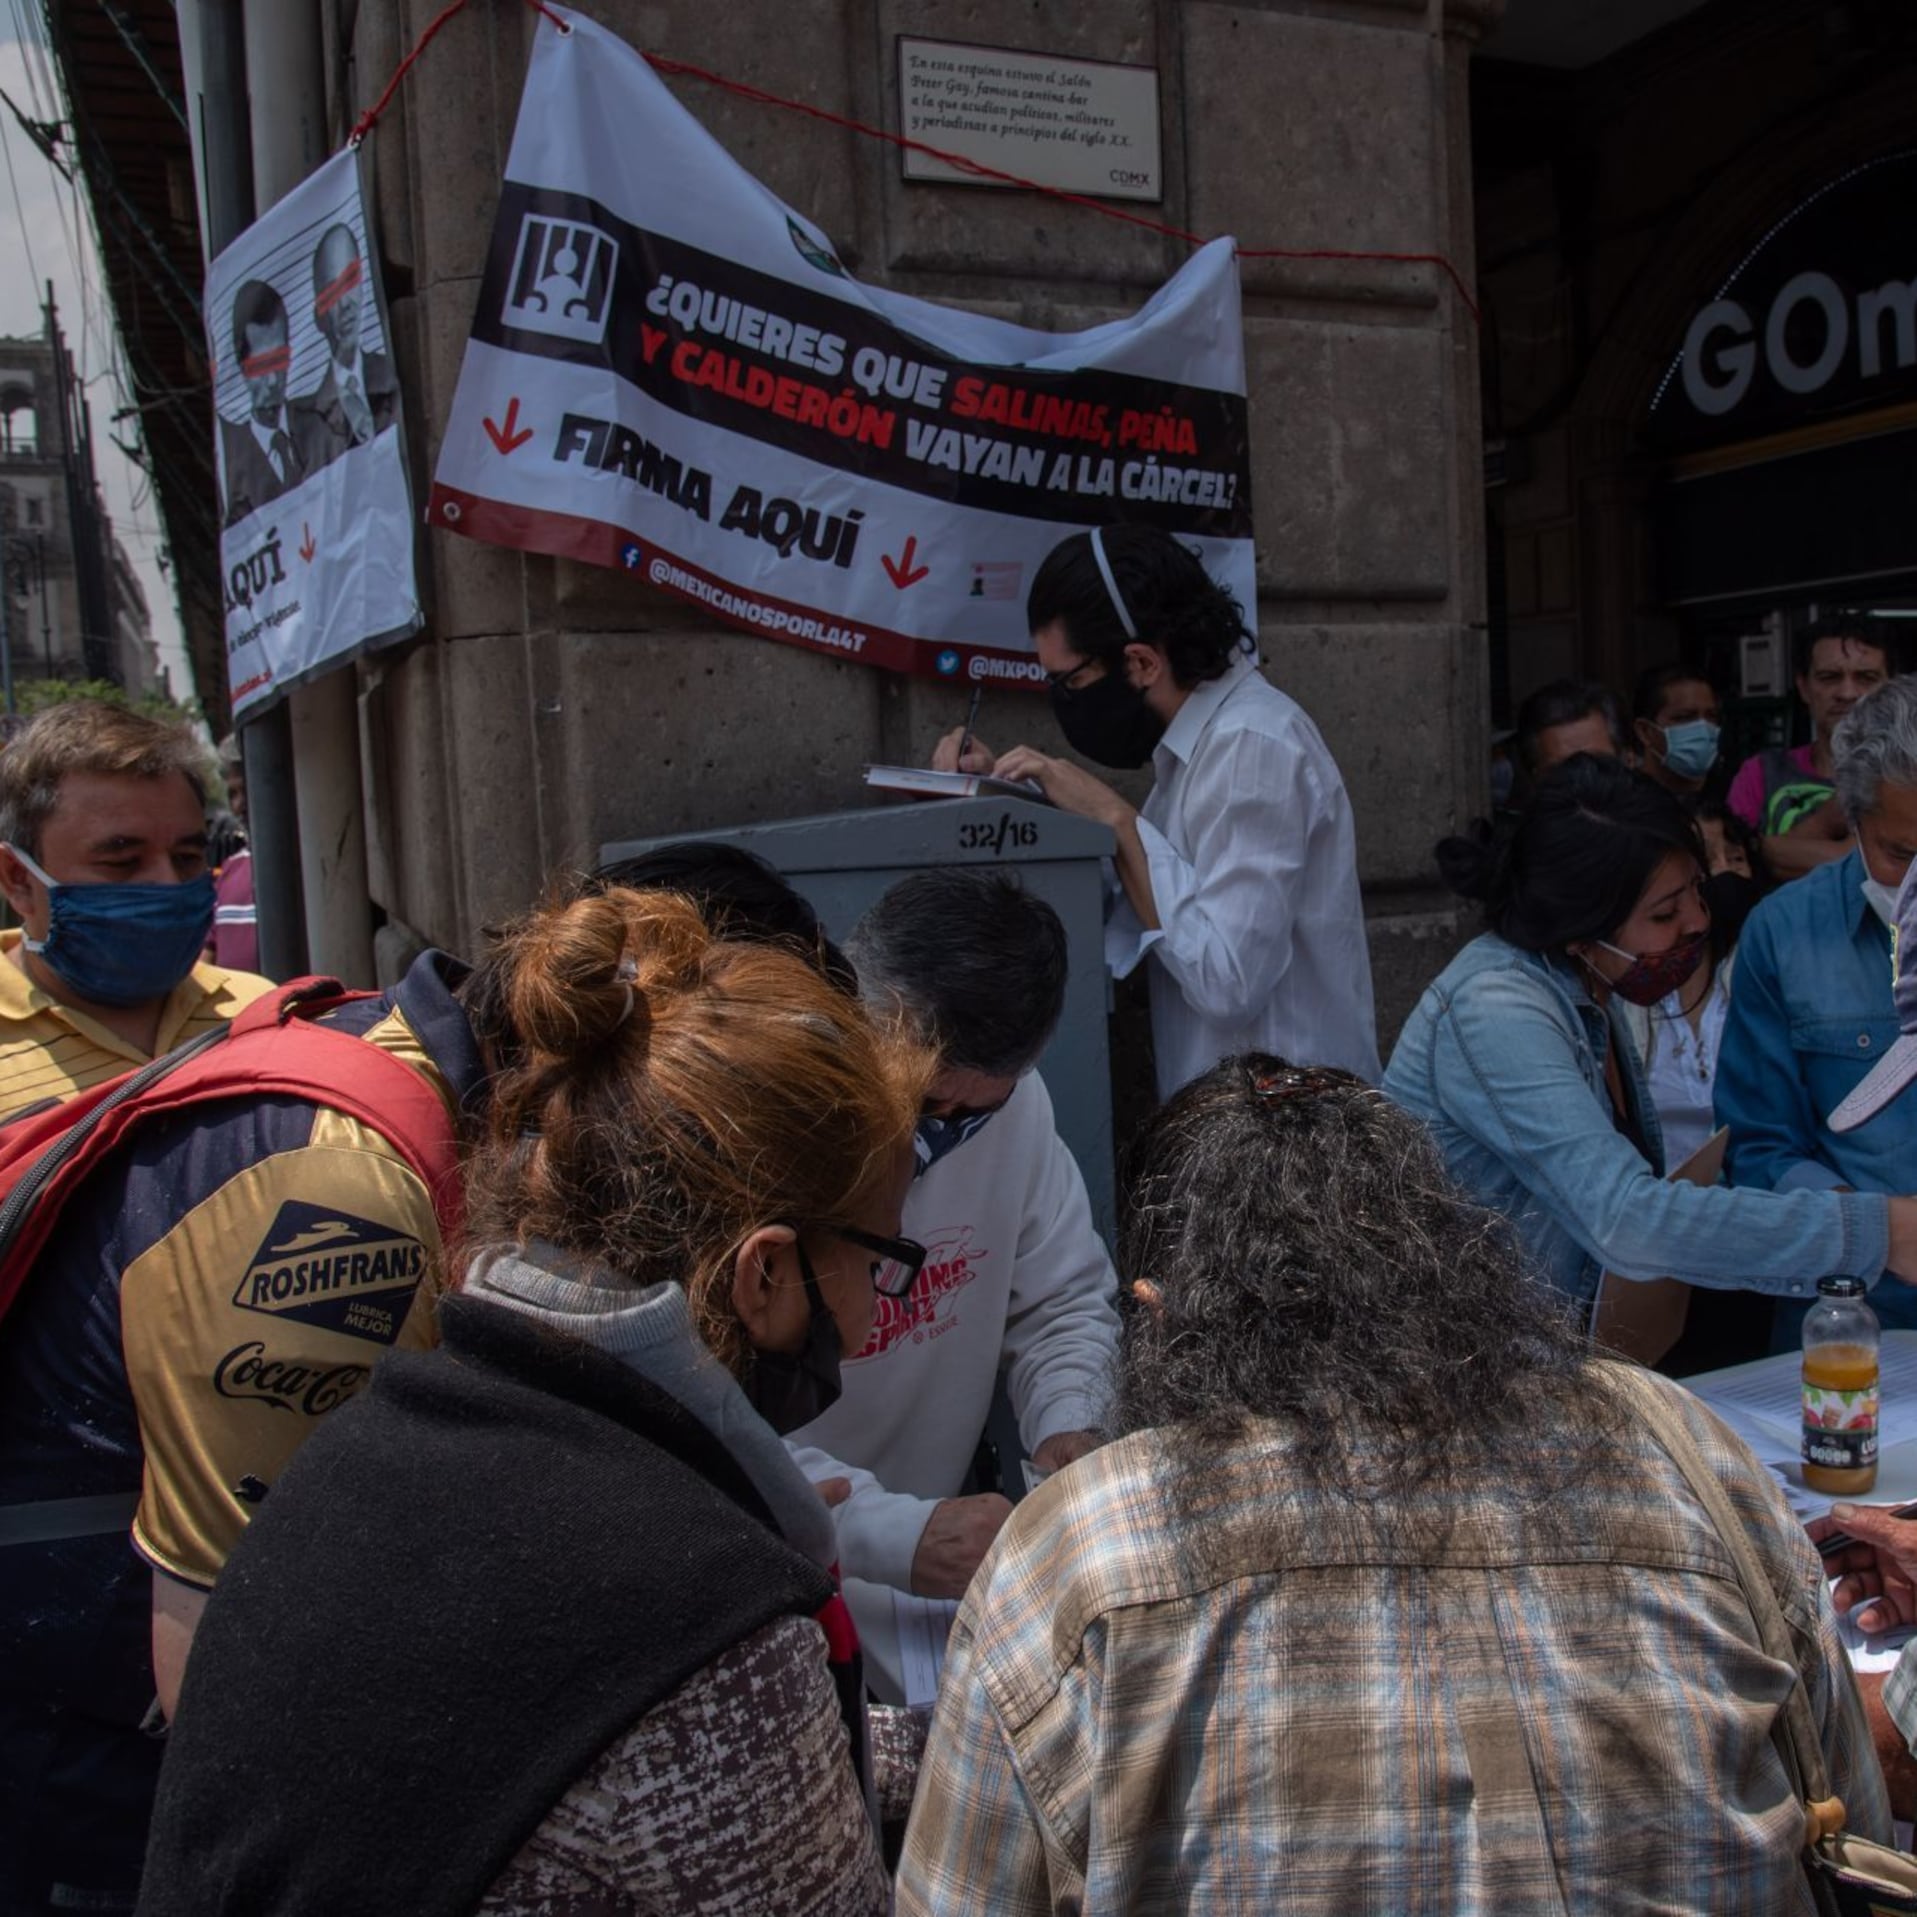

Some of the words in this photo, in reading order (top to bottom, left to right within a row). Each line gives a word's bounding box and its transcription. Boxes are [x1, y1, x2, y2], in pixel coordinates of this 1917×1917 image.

[909, 56, 927, 69] En
[931, 61, 955, 72] esta
[957, 65, 1002, 79] esquina
[1006, 70, 1043, 82] estuvo
[1046, 71, 1057, 83] el
[911, 75, 943, 88] Peter
[974, 81, 1018, 98] famosa
[922, 94, 934, 107] la
[937, 99, 958, 113] que
[1065, 110, 1115, 127] militares
[922, 116, 987, 132] periodistas
[990, 123, 998, 133] a
[1000, 124, 1057, 142] principios
[1060, 127, 1077, 142] del
[1080, 131, 1106, 148] siglo
[1110, 169, 1149, 185] CDMX
[645, 273, 848, 377] ¿QUIERES
[851, 346, 948, 410] QUE
[950, 375, 1113, 449] SALINAS,
[1118, 404, 1199, 457] PEÑA
[640, 321, 668, 366] Y
[671, 340, 897, 450] CALDERÓN
[904, 418, 1047, 488] VAYAN
[1046, 452, 1074, 493] A
[1075, 455, 1115, 498] LA
[1119, 455, 1239, 511] CÁRCEL?
[552, 413, 713, 522] FIRMA
[719, 485, 865, 569] AQUÍ
[648, 557, 868, 653] @MEXICANOSPORLA4T
[967, 655, 1049, 682] @MXPO
[959, 813, 1038, 855] 32/16
[251, 1243, 421, 1305] ROSHFRANS
[343, 1313, 393, 1337] MEJOR
[348, 1301, 393, 1322] LUBRICA
